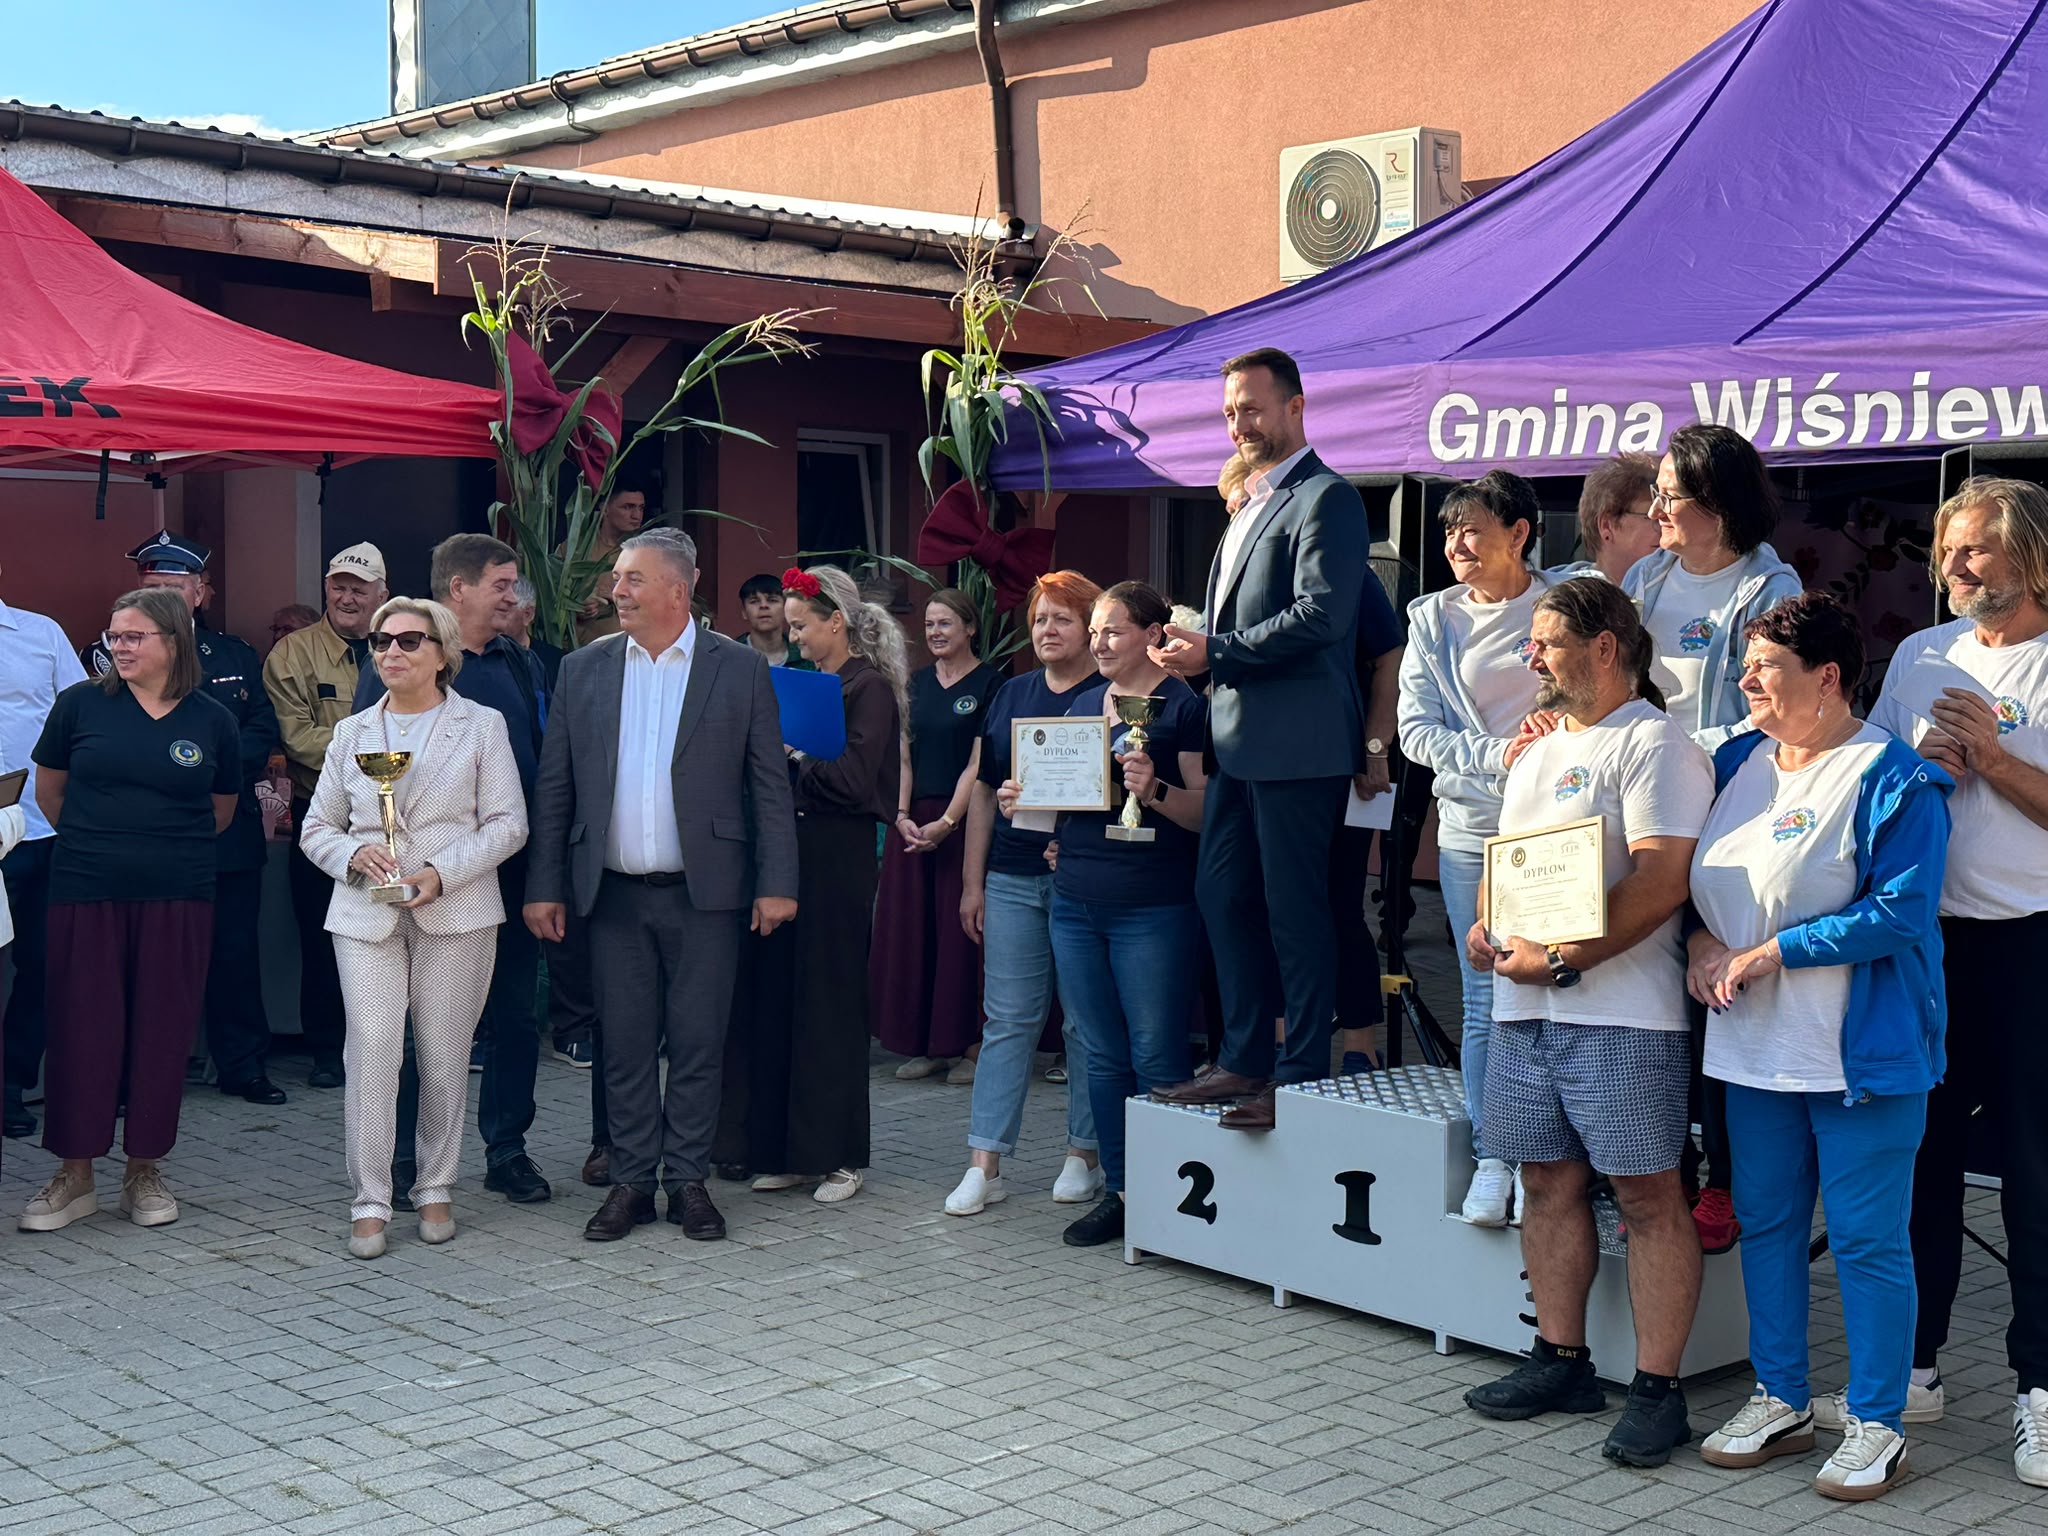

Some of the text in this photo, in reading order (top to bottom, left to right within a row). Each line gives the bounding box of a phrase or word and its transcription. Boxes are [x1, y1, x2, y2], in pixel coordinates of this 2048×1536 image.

[1429, 388, 1664, 461] Gmina
[1043, 747, 1079, 756] DYPLOM
[1523, 863, 1566, 879] DYPLOM
[1176, 1161, 1217, 1225] 2
[1332, 1170, 1382, 1245] 1
